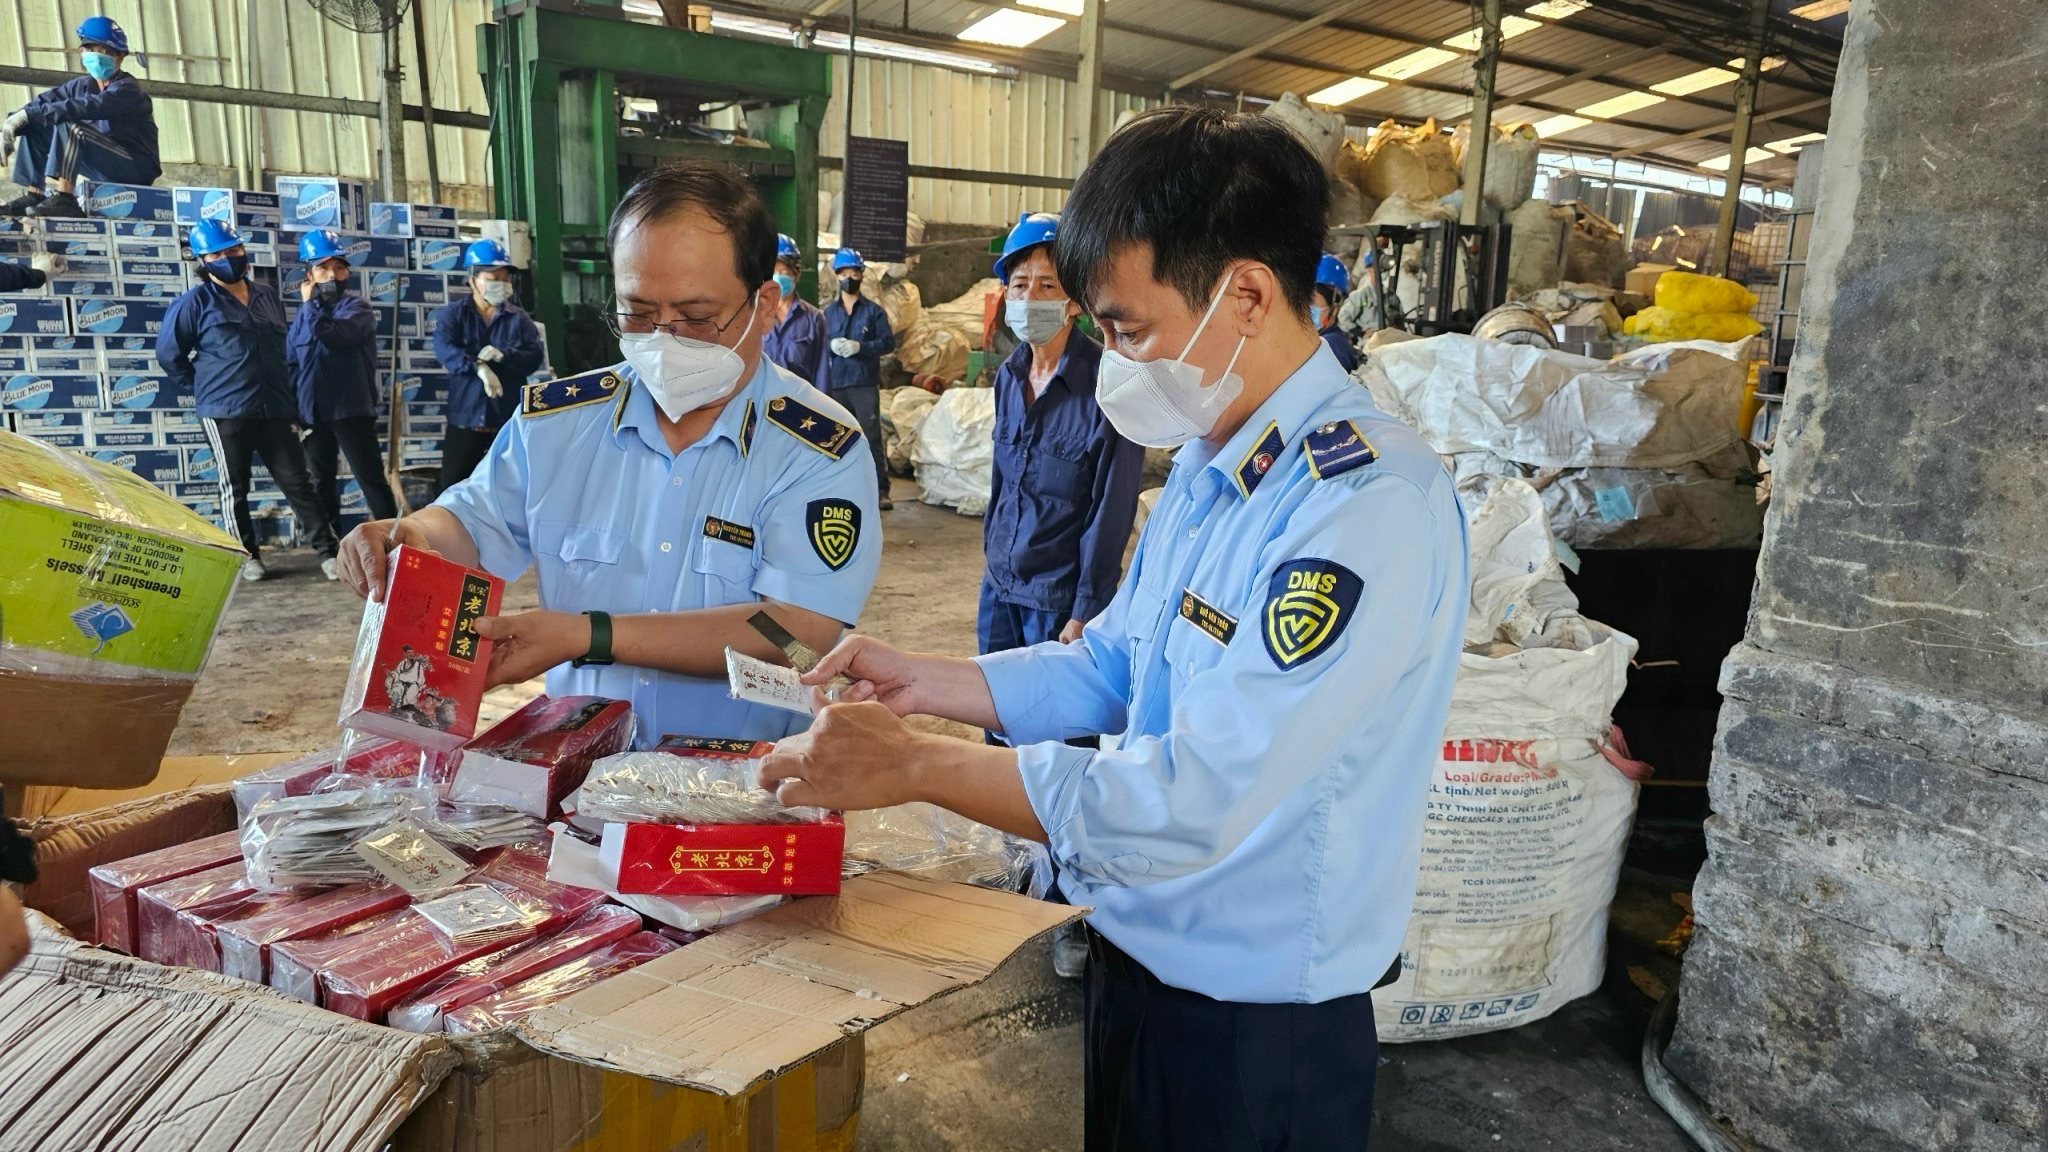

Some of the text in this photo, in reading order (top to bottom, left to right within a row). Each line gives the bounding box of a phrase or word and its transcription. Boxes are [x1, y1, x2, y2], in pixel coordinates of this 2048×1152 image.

[91, 194, 136, 209] BLUE MOON
[284, 281, 301, 292] BLU
[80, 307, 125, 326] BLUE MOON
[4, 382, 51, 402] BLUE MOON
[113, 383, 158, 402] BLUE MOON
[823, 506, 853, 521] DMS
[61, 538, 93, 555] SHELL
[126, 544, 141, 554] OF
[137, 537, 165, 549] FROZEN
[170, 544, 184, 553] KEEP
[123, 553, 141, 565] THE
[144, 549, 181, 563] PRODUCT
[144, 557, 159, 570] ON
[1288, 571, 1337, 594] DMS
[1445, 786, 1498, 798] tịnh/Net
[1500, 786, 1543, 798] weight:
[1437, 802, 1452, 811] TY
[1455, 805, 1486, 813] TNHH
[1446, 814, 1504, 824] CHEMICALS
[1507, 814, 1544, 824] VIETNAM
[688, 851, 755, 868] 老北京
